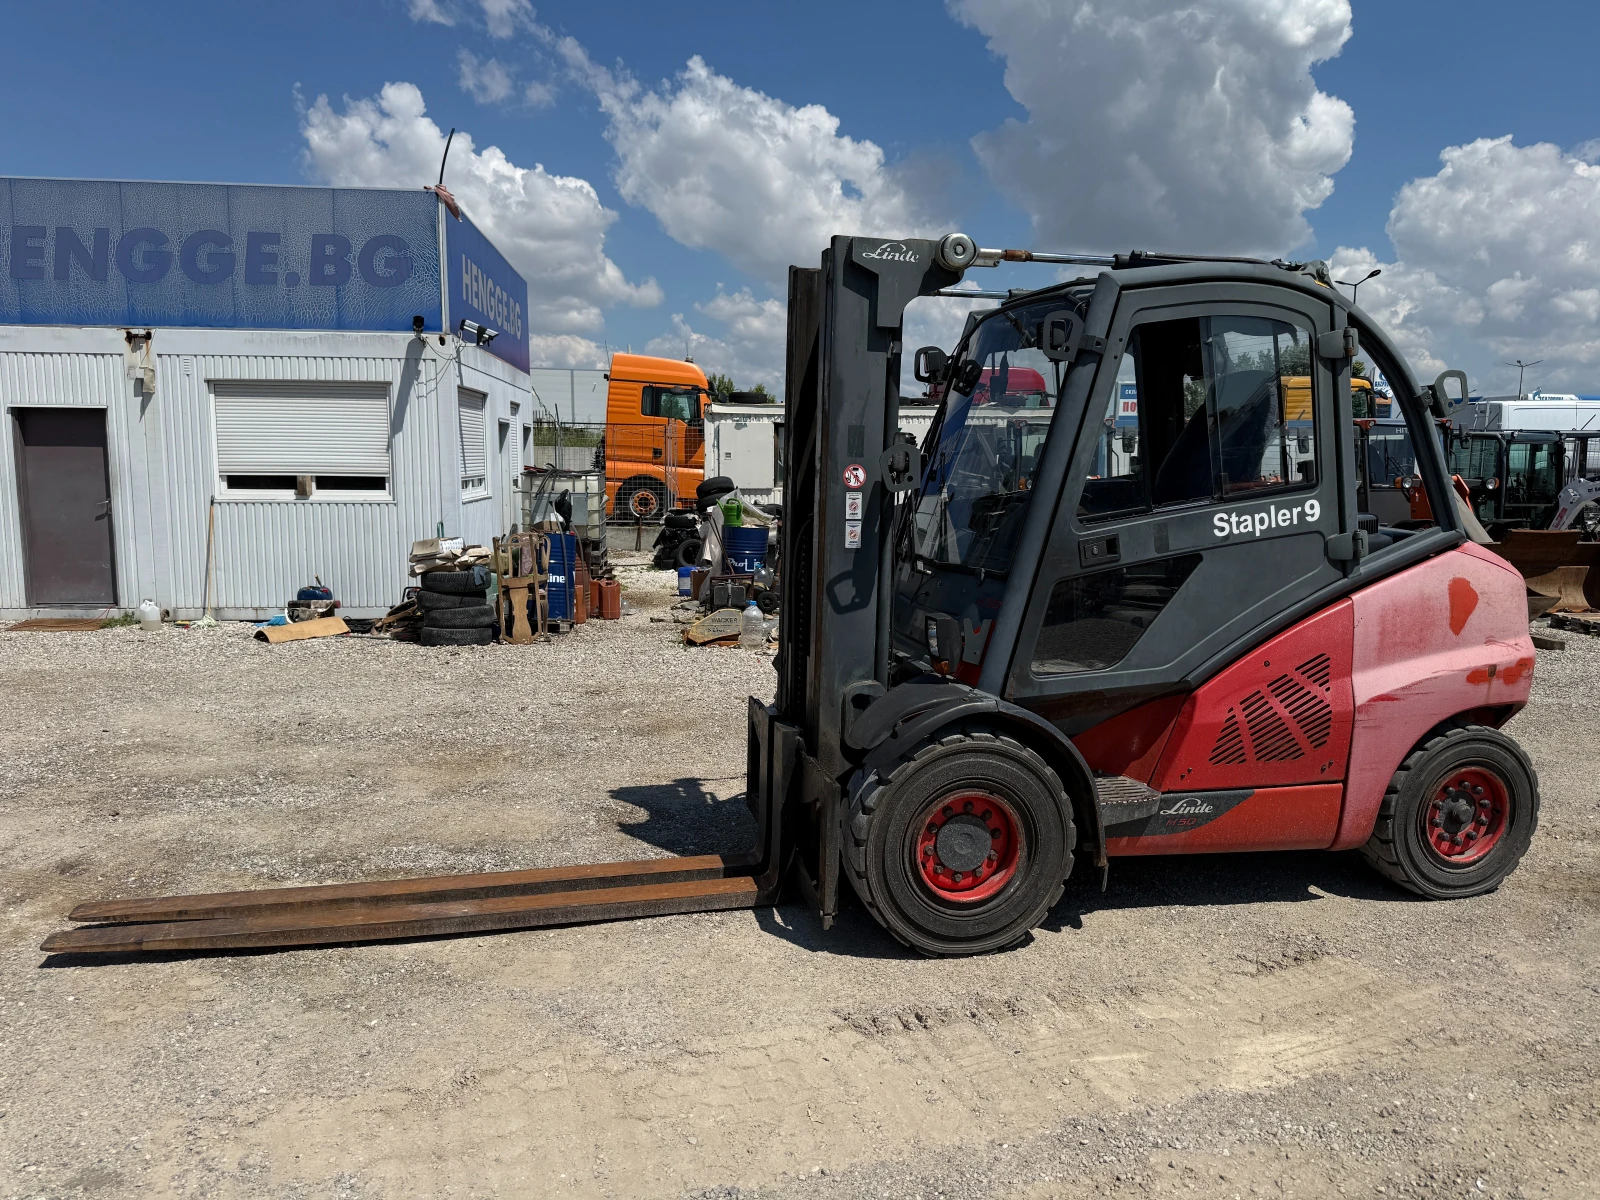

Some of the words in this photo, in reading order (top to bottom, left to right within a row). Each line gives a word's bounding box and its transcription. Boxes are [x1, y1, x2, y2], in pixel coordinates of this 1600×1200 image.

[9, 226, 414, 288] ENGGE.BG
[862, 242, 919, 262] Linde
[462, 253, 522, 340] HENGGE.BG
[1213, 504, 1302, 537] Stapler
[1304, 499, 1321, 522] 9
[1160, 798, 1213, 815] Linde
